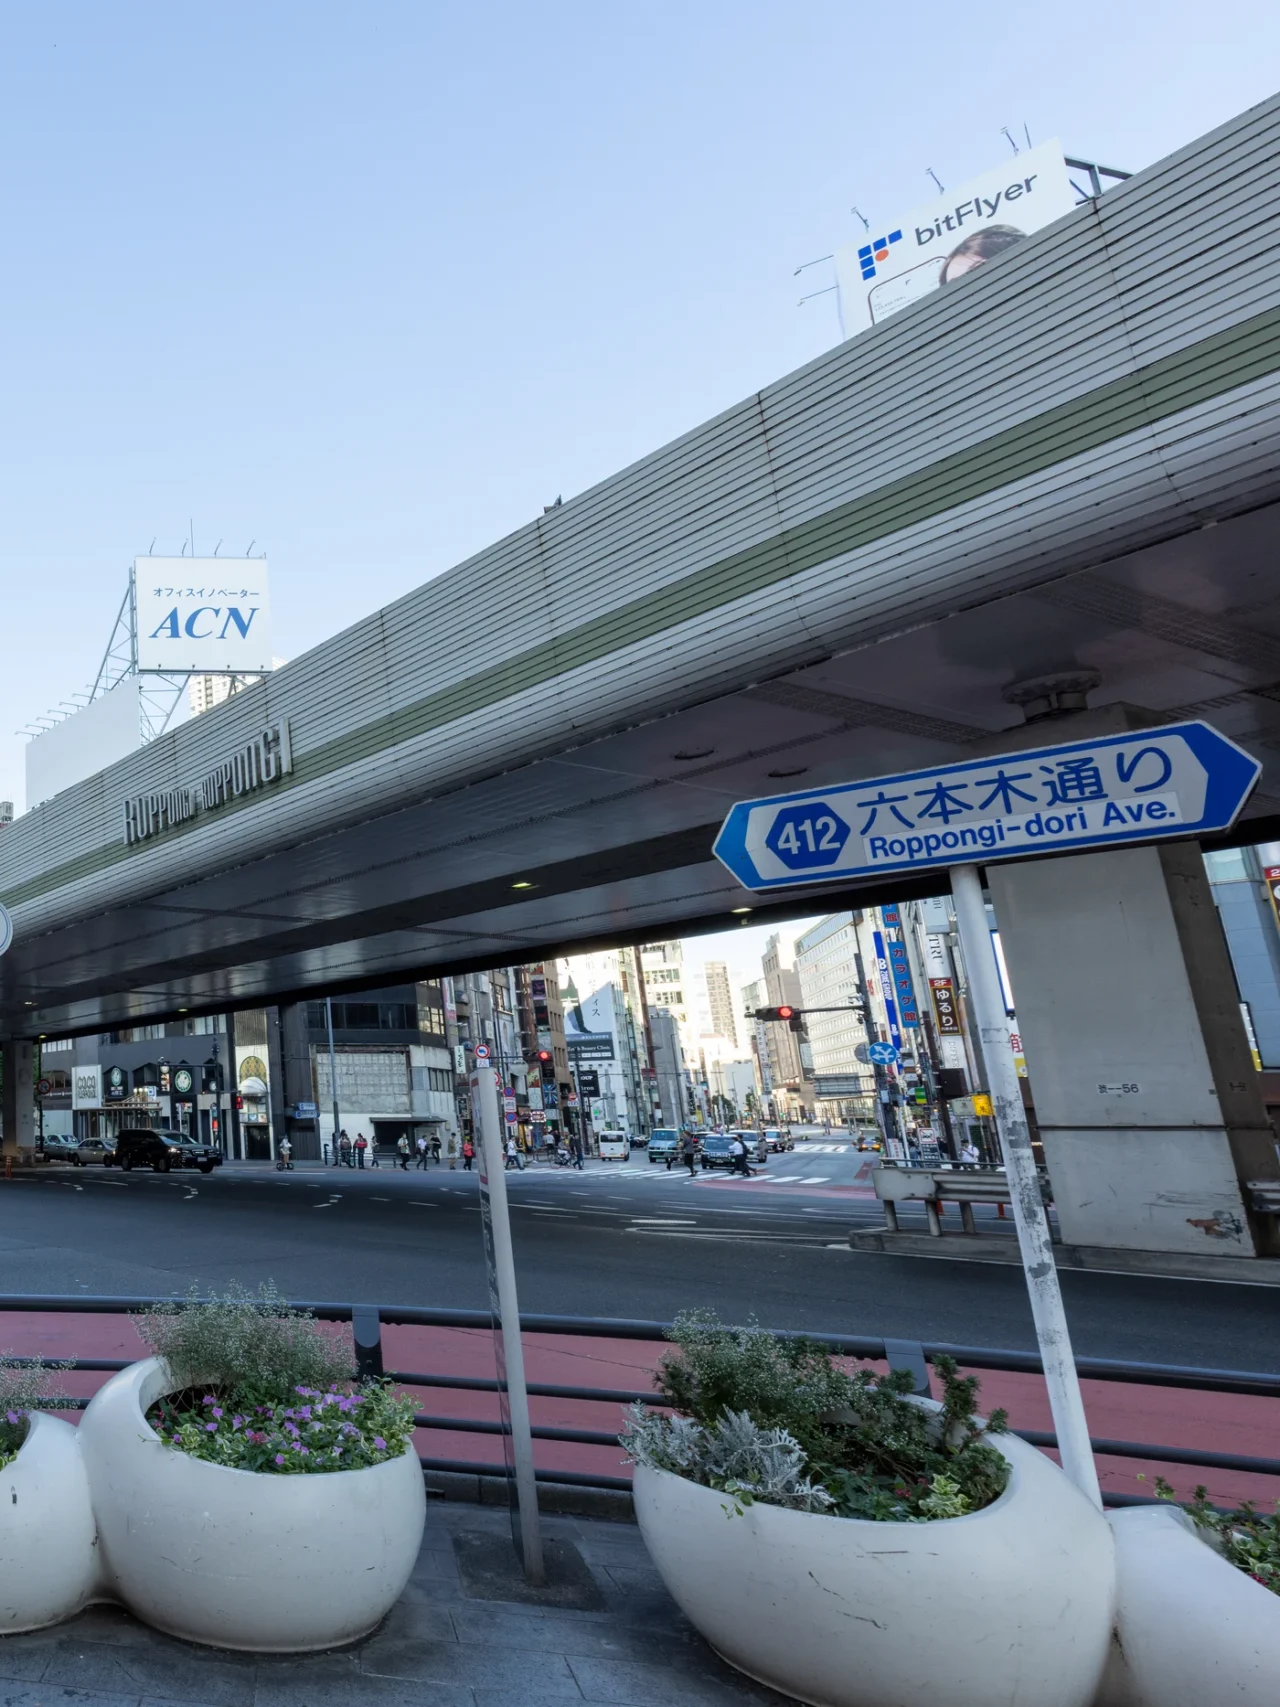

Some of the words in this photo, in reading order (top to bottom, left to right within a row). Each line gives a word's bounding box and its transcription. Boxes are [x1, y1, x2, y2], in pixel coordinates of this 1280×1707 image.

[914, 174, 1038, 246] bitFlyer
[148, 606, 260, 639] ACN
[153, 588, 260, 598] オフィスイノベーター
[122, 788, 196, 845] ROPPONGI
[200, 716, 293, 810] ROPPONGI
[857, 746, 1172, 836] 六本木通り
[776, 816, 841, 855] 412
[870, 806, 1088, 862] Roppongi-dori
[1102, 799, 1177, 829] Ave.
[893, 949, 917, 1021] カラオケ館
[936, 989, 953, 1026] ゆるり
